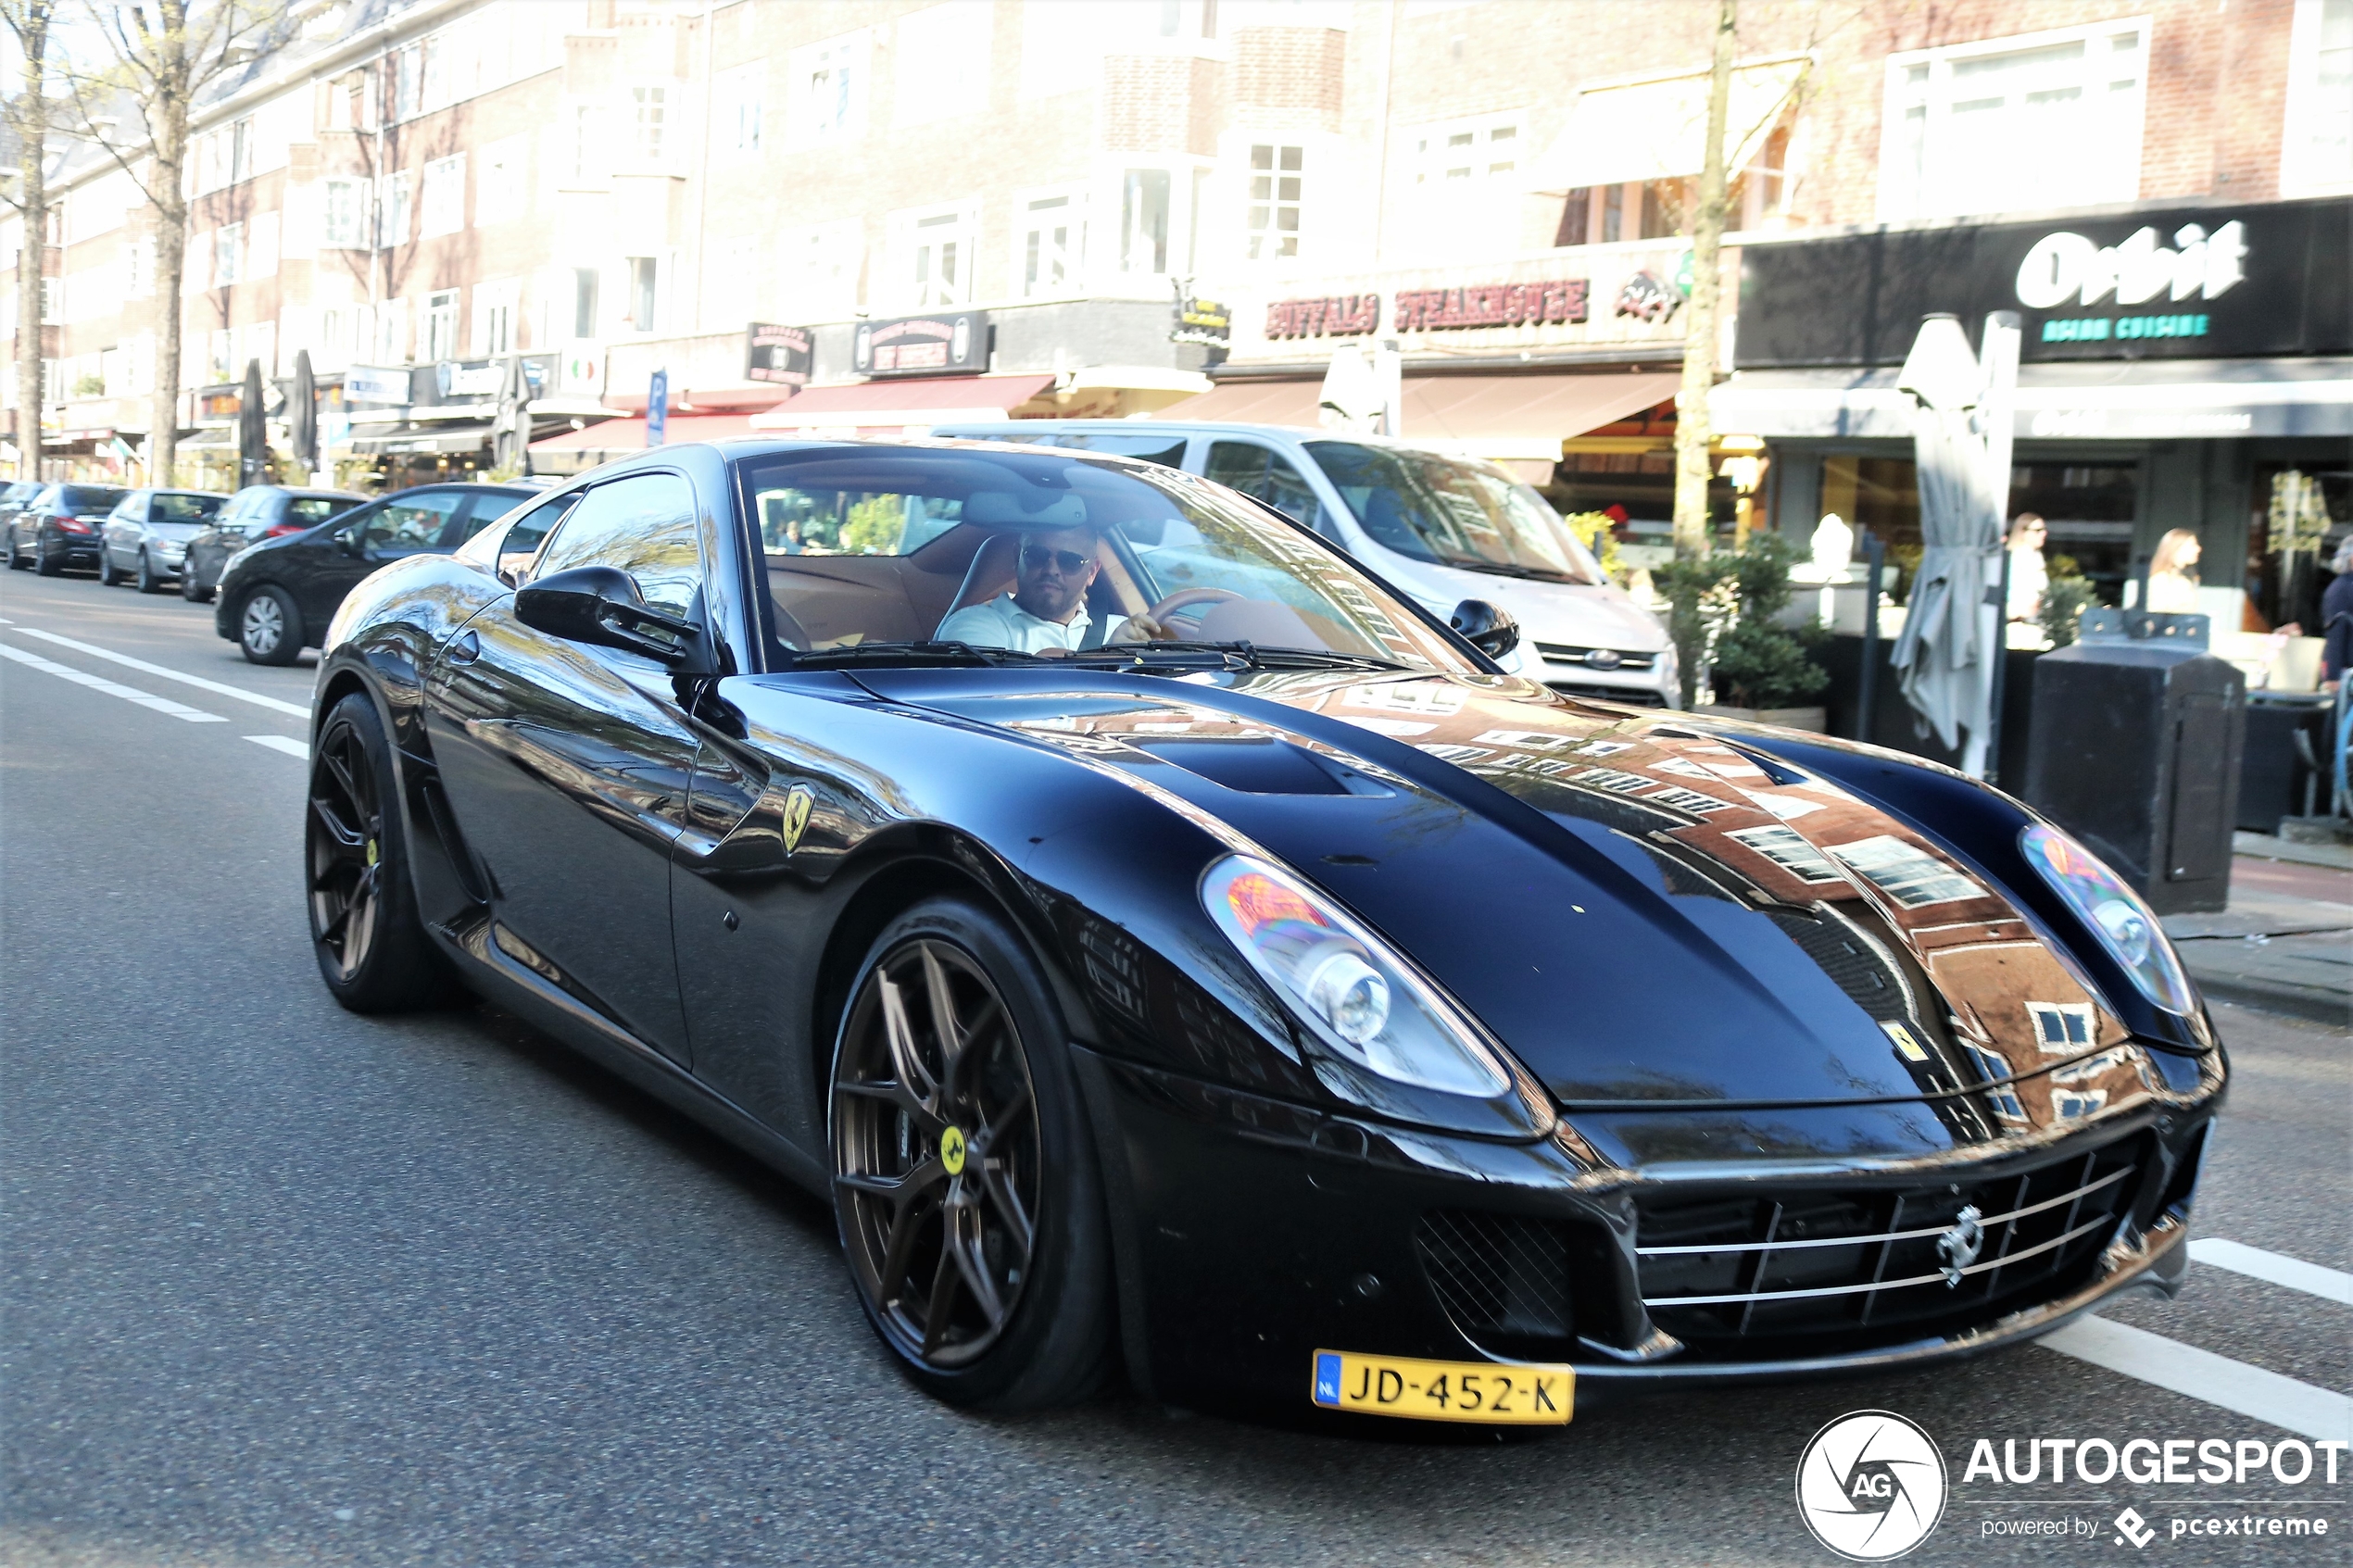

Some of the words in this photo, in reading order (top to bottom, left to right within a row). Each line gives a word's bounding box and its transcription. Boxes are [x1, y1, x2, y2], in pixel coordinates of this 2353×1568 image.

[2016, 220, 2249, 308] Orbit
[1265, 294, 1378, 340] BUFFALO
[1394, 279, 1591, 332] STEAKHOUSE
[2042, 318, 2111, 343] ASIAN
[2116, 315, 2209, 339] CUISINE
[1350, 1366, 1557, 1413] JD-452-K
